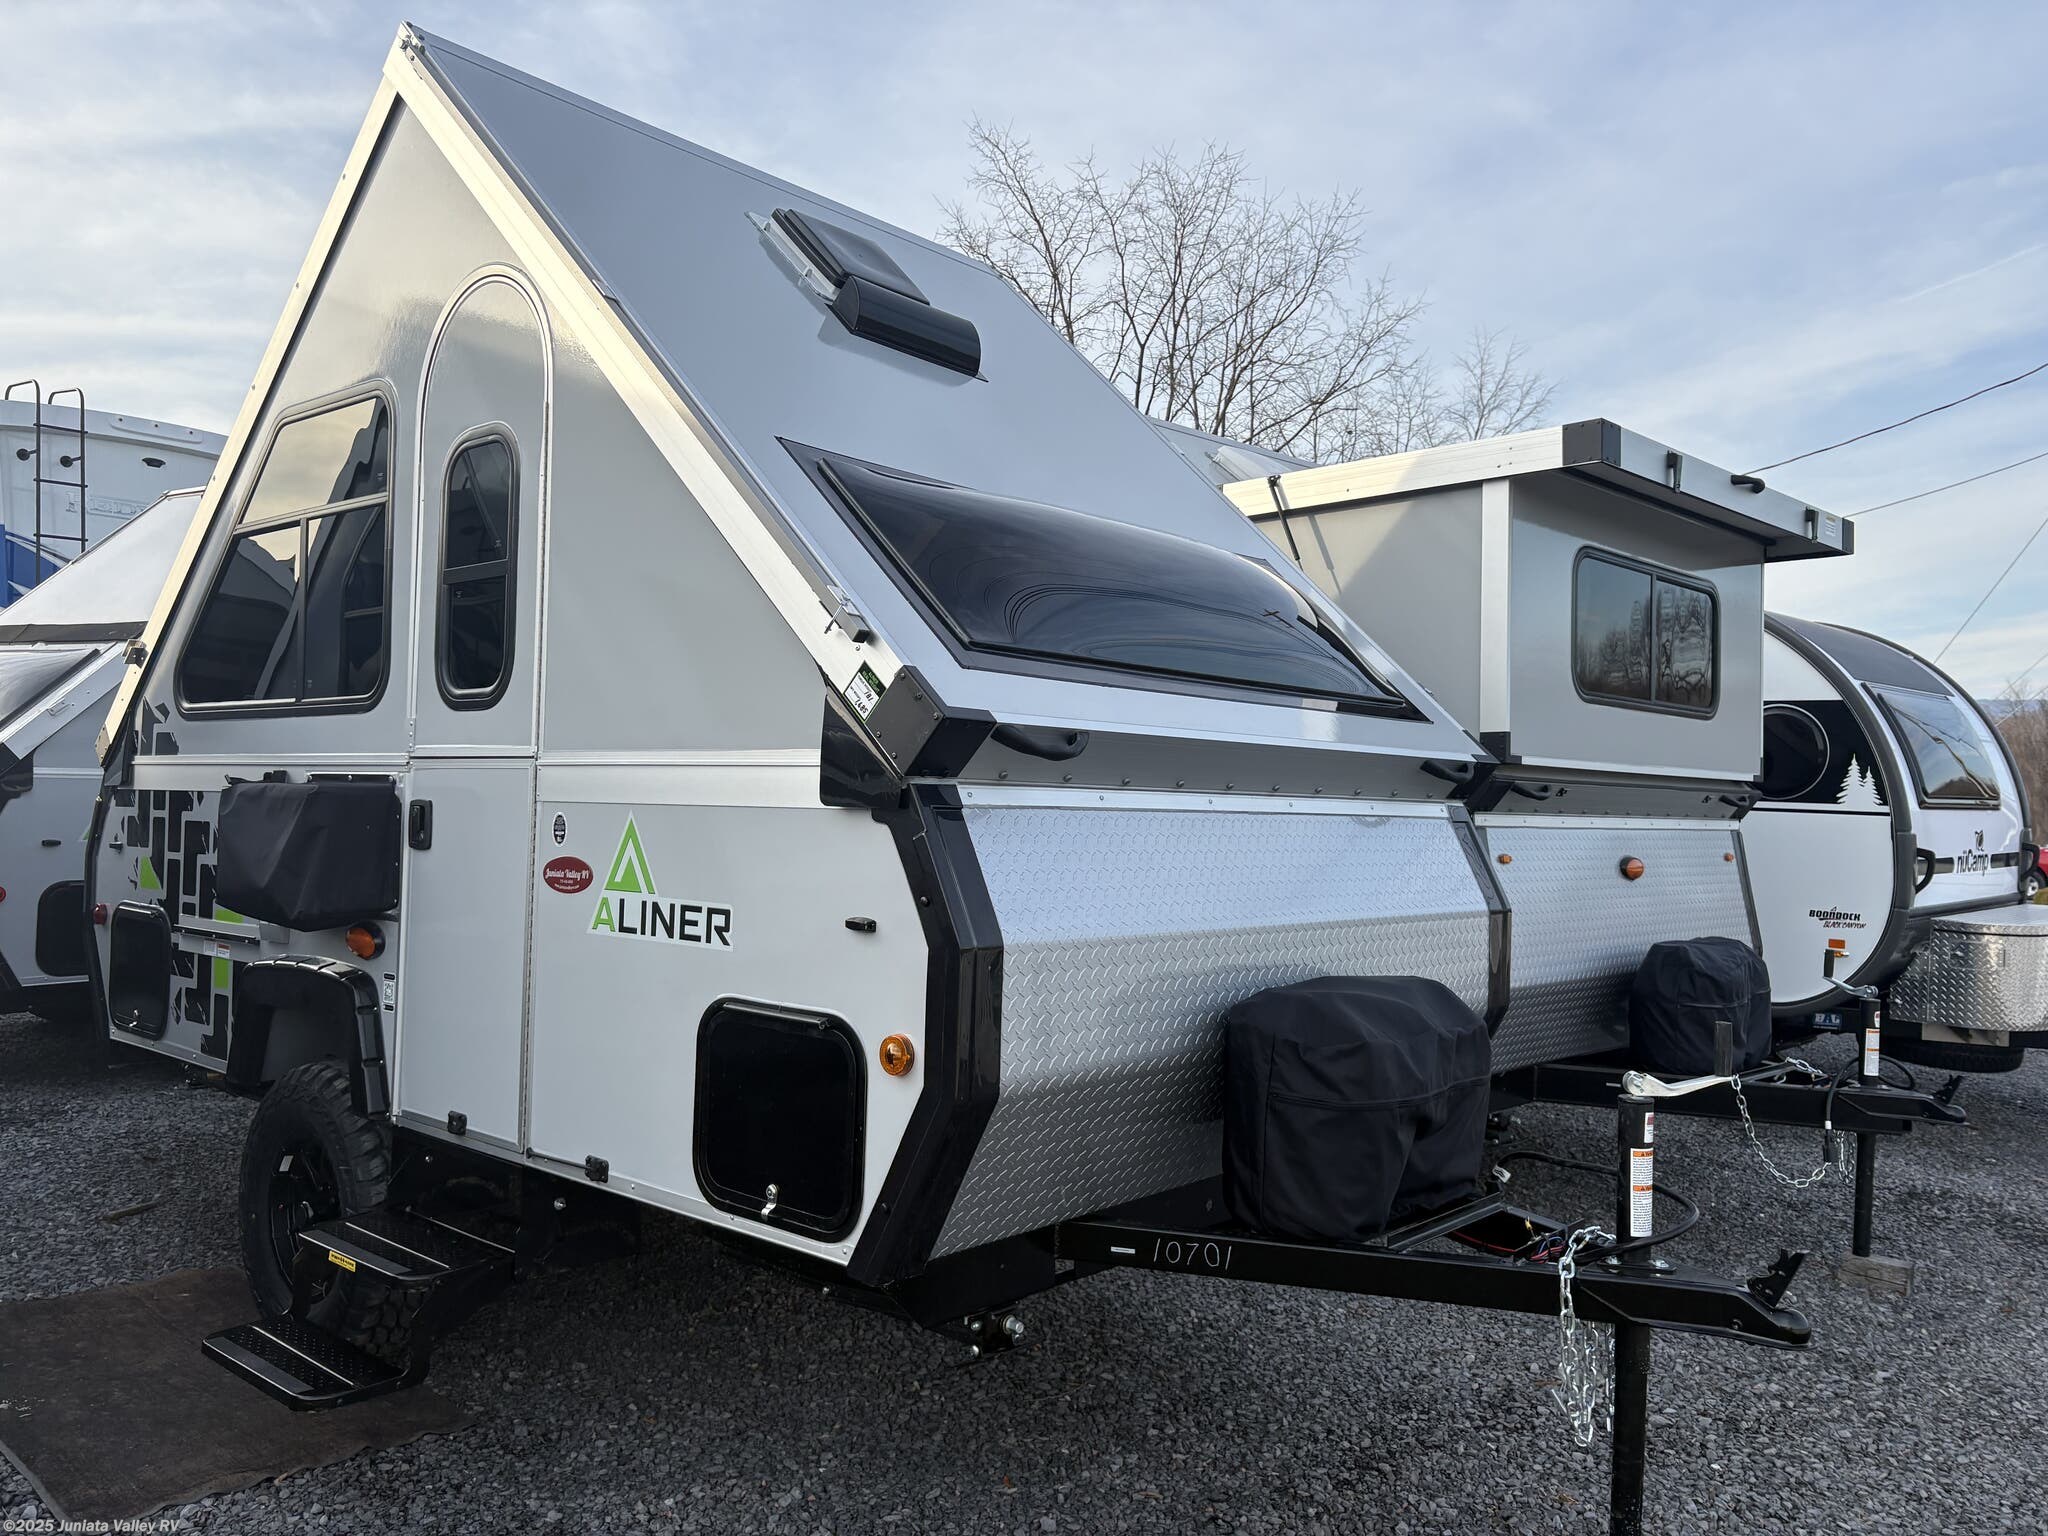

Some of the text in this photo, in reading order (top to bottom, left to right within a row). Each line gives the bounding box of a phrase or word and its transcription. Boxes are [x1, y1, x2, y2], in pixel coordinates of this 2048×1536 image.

[1956, 848, 1989, 877] nüCamp
[591, 896, 731, 946] ALINER
[1808, 909, 1861, 921] BOONDOCK
[1153, 1238, 1232, 1271] 10701
